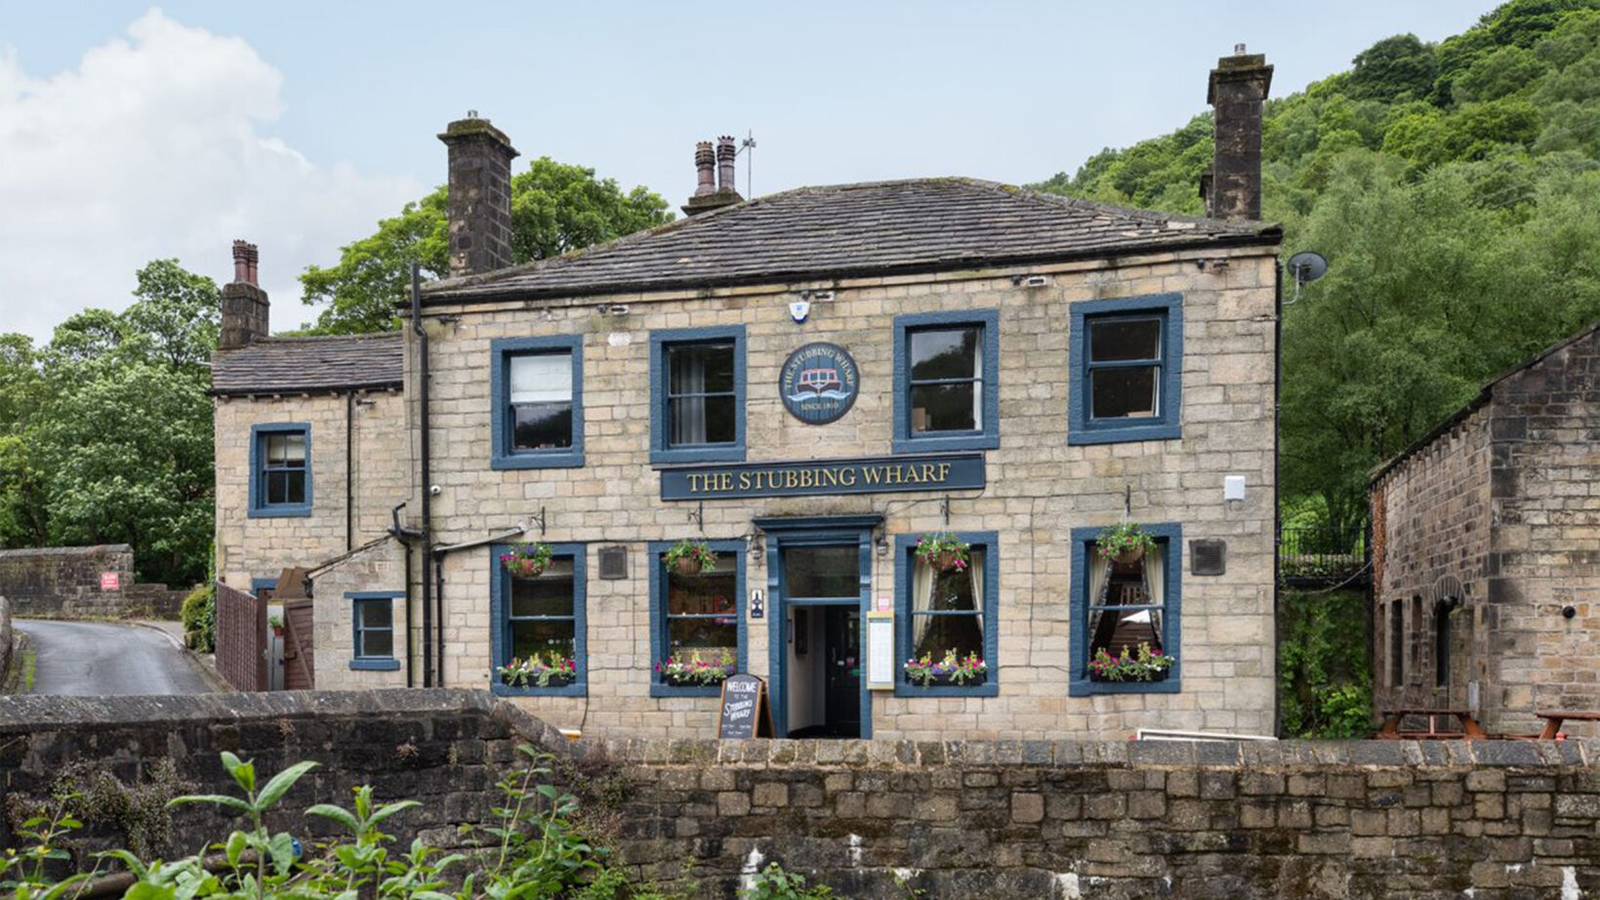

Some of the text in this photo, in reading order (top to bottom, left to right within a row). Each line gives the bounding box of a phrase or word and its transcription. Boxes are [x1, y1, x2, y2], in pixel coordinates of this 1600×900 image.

[792, 348, 835, 369] STUBBING
[836, 353, 854, 385] WHARF
[687, 463, 951, 492] THE STUBBING WHARF
[727, 681, 757, 692] WELCOME
